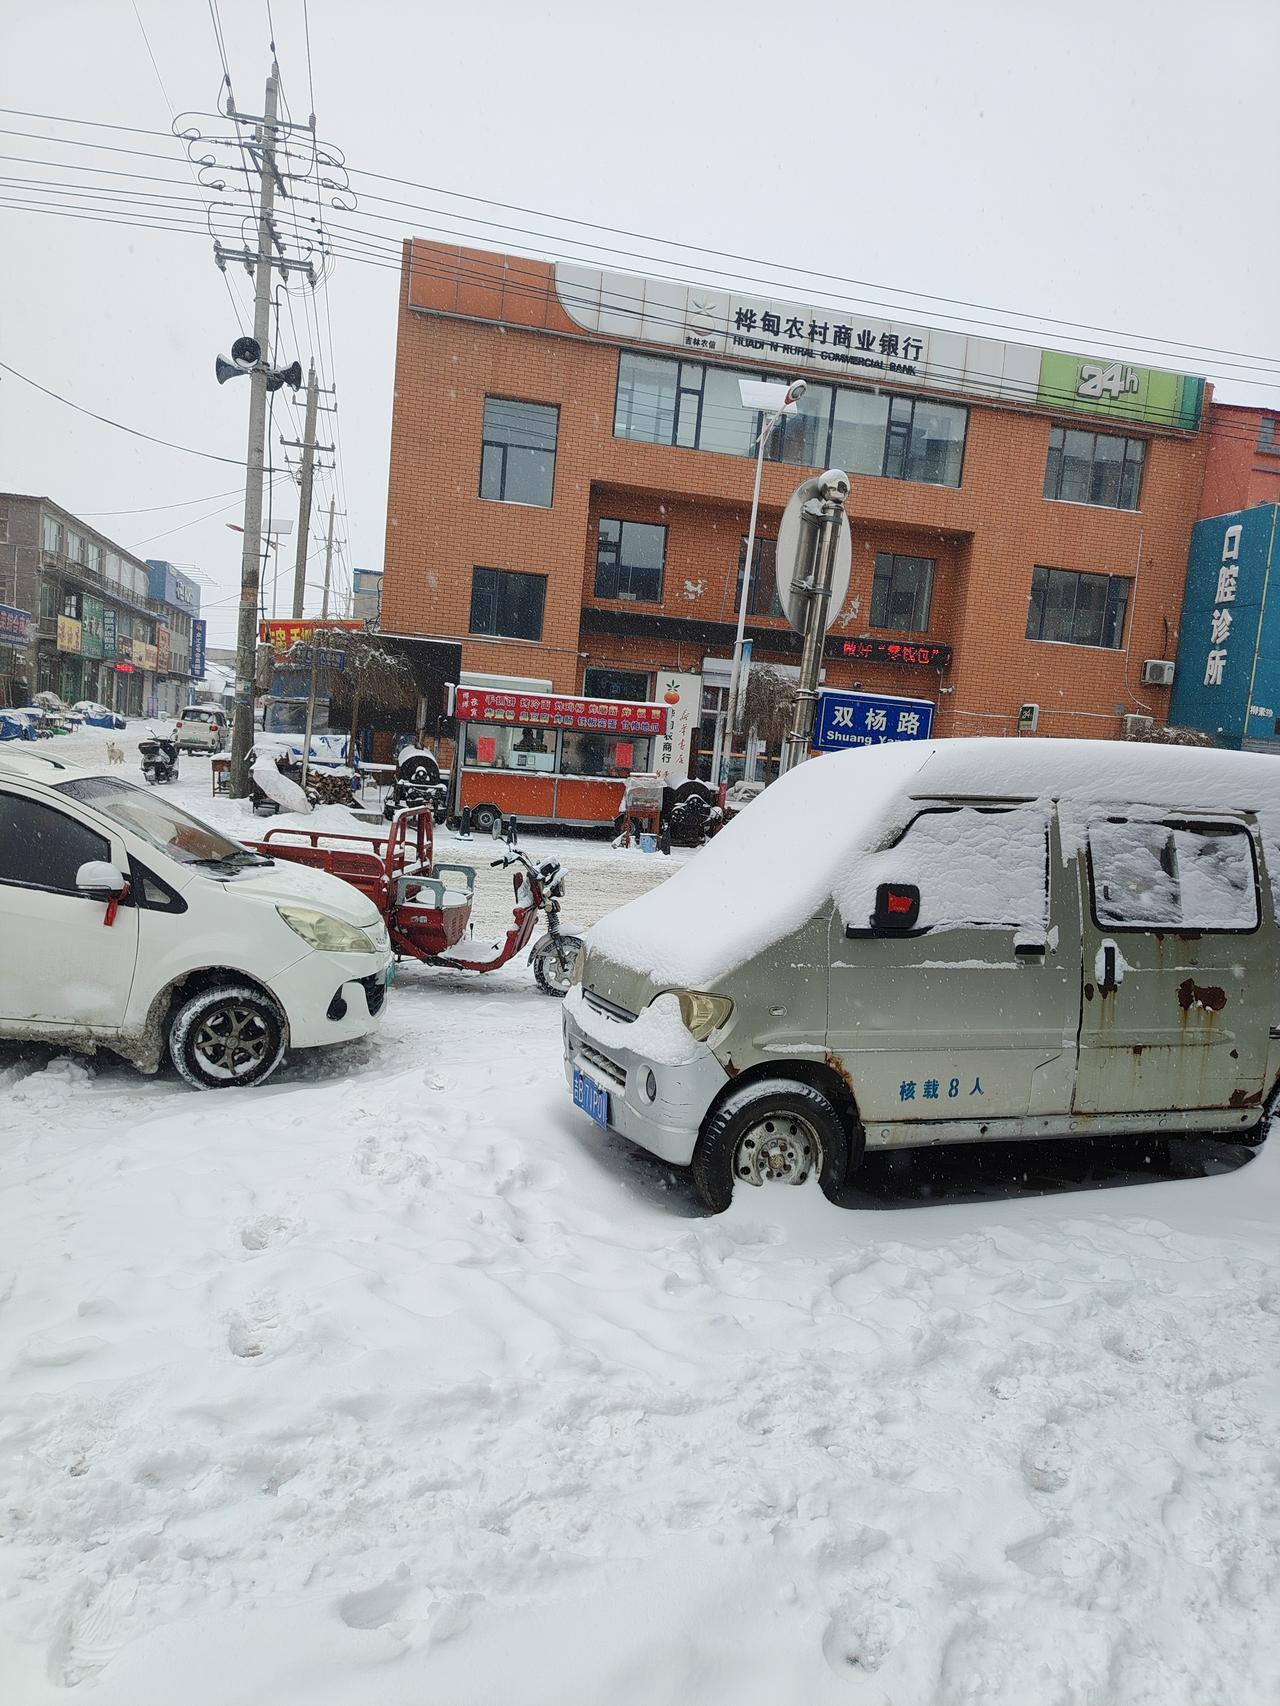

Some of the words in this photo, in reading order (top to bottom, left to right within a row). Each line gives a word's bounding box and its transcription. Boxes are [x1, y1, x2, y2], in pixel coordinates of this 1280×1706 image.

[685, 335, 716, 350] 吉林农信
[733, 307, 924, 362] 桦甸农村商业银行
[783, 343, 816, 359] RURAL
[820, 350, 887, 370] COMMERCIAL
[889, 362, 918, 376] BANK
[1076, 362, 1139, 400] 24h
[1203, 524, 1243, 686] 口腔诊所
[832, 705, 921, 736] 双杨路
[826, 730, 873, 746] Shuang
[899, 1077, 985, 1102] 核载8人
